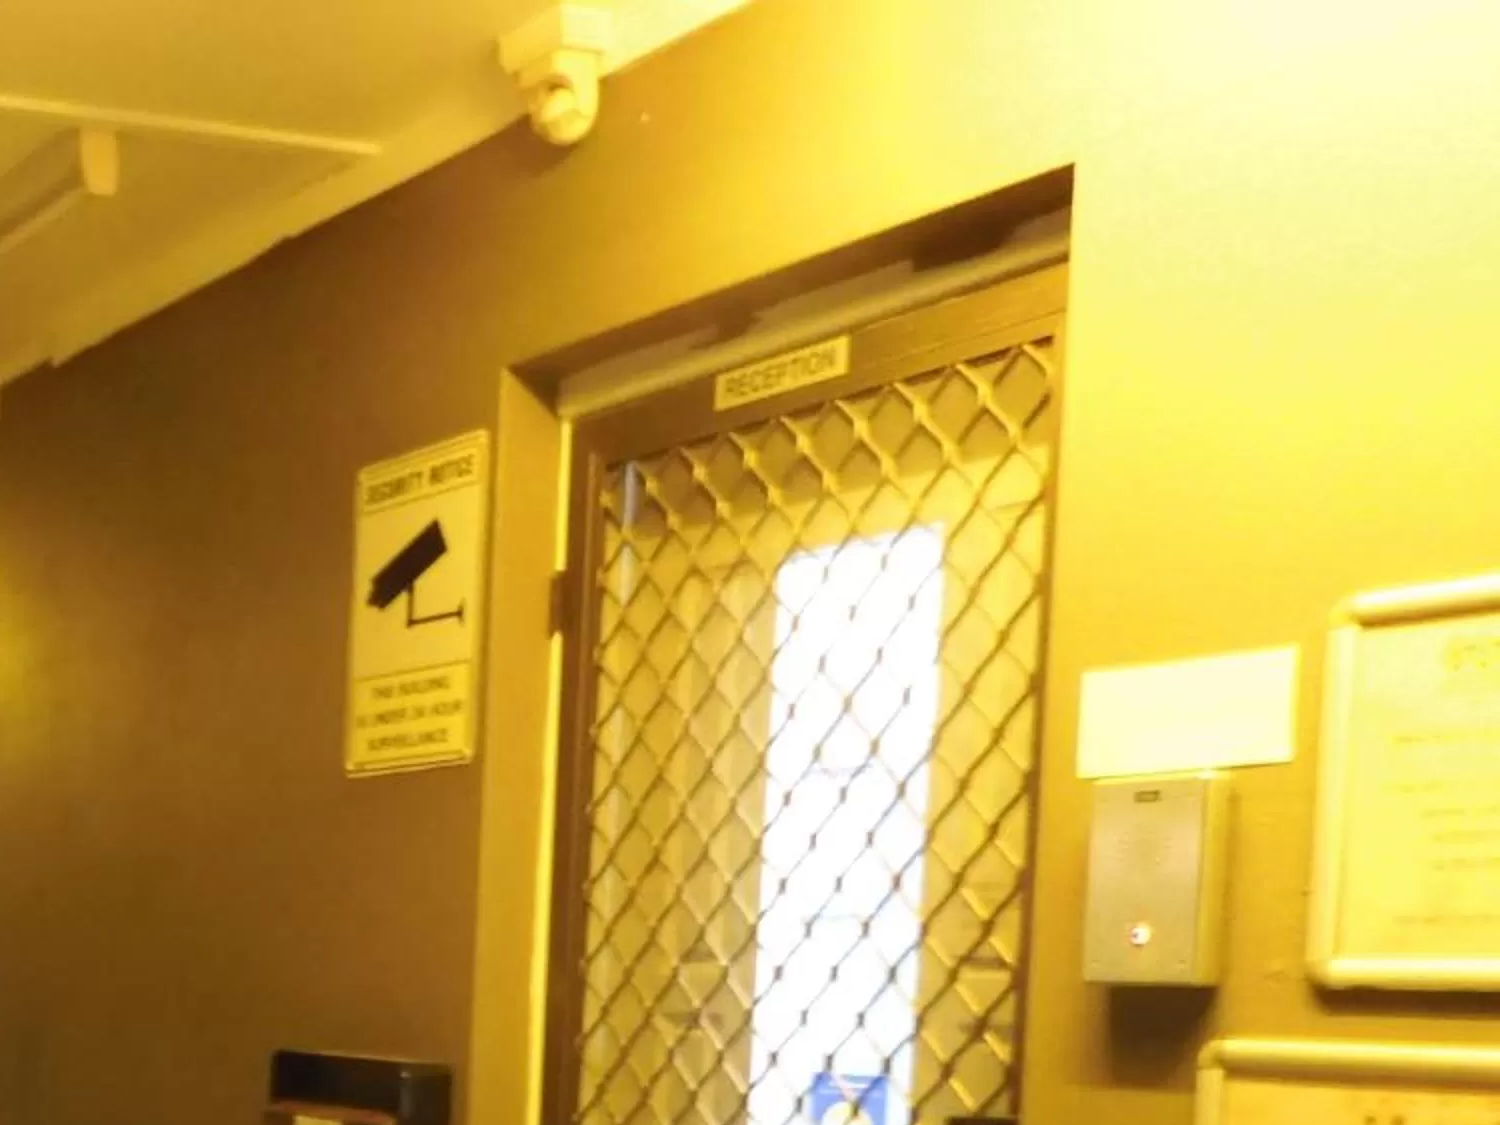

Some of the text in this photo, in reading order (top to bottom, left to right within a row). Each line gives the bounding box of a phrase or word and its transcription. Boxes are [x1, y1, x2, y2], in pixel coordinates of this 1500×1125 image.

[724, 347, 837, 400] RECEPTION
[365, 453, 475, 506] SECURITY NOTICE
